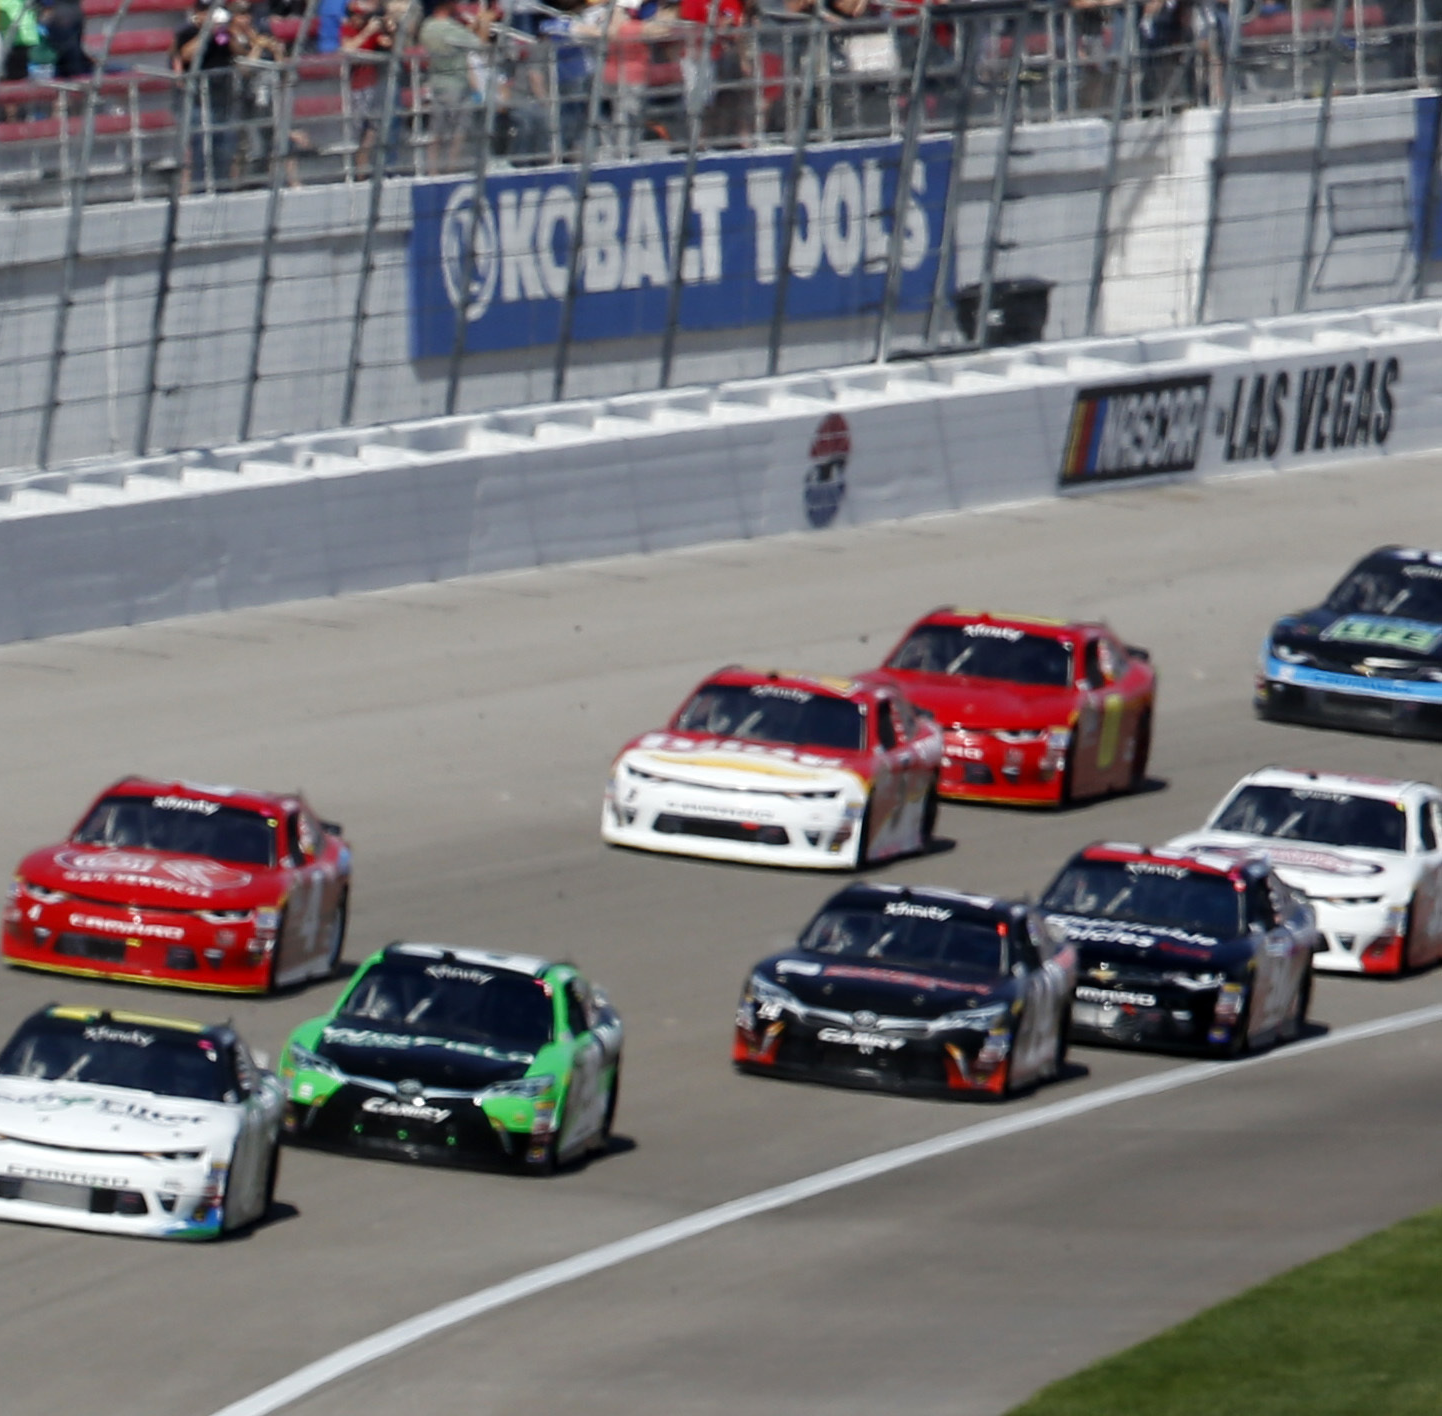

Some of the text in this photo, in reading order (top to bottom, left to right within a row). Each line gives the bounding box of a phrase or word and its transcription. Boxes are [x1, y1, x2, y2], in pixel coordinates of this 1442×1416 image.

[500, 157, 931, 301] KOBALT TOOLS
[1223, 371, 1289, 462] LAS
[1294, 357, 1401, 453] VEGAS
